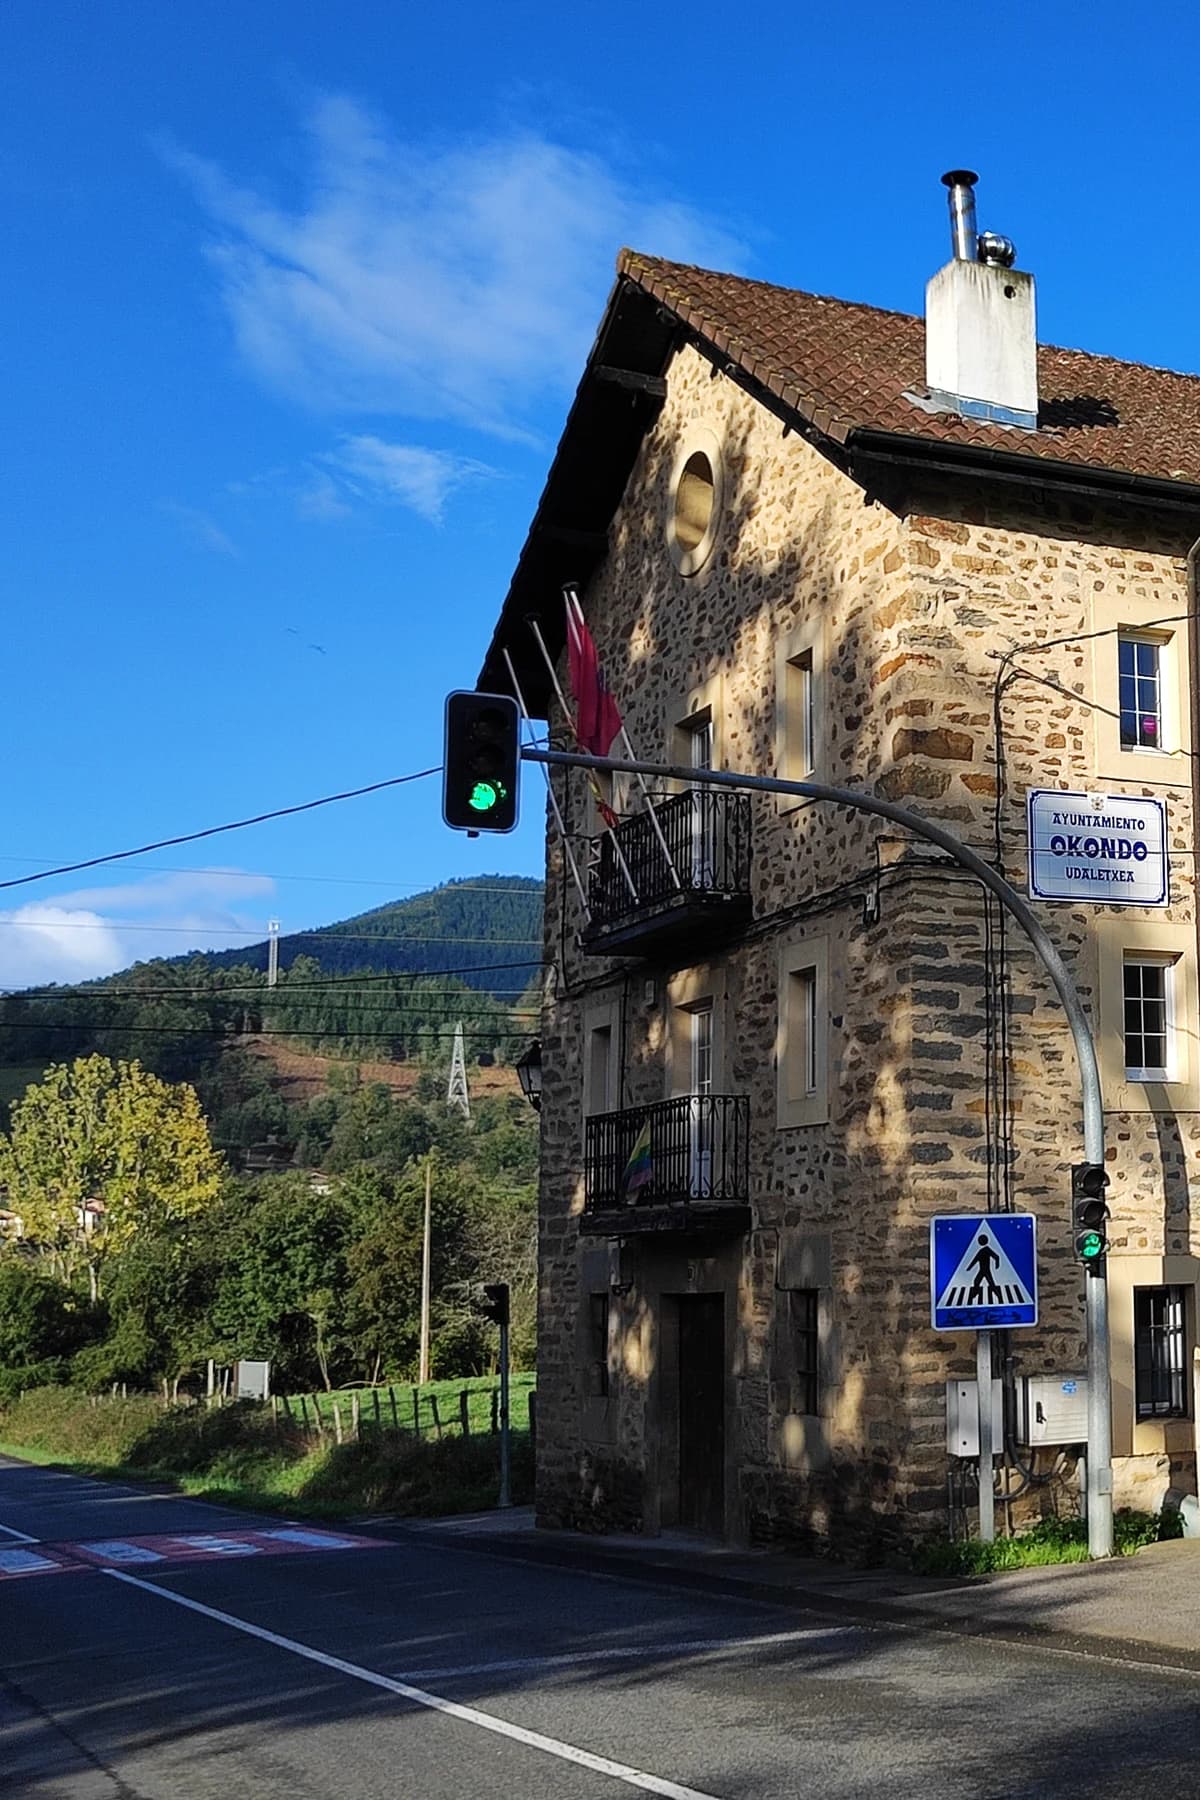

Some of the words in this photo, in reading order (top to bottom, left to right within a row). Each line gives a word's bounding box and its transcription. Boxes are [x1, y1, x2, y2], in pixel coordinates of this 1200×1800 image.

[1052, 812, 1146, 831] AYUNTAMIENTO
[1050, 835, 1148, 862] OKONDO
[1065, 866, 1135, 883] UDALETXEA
